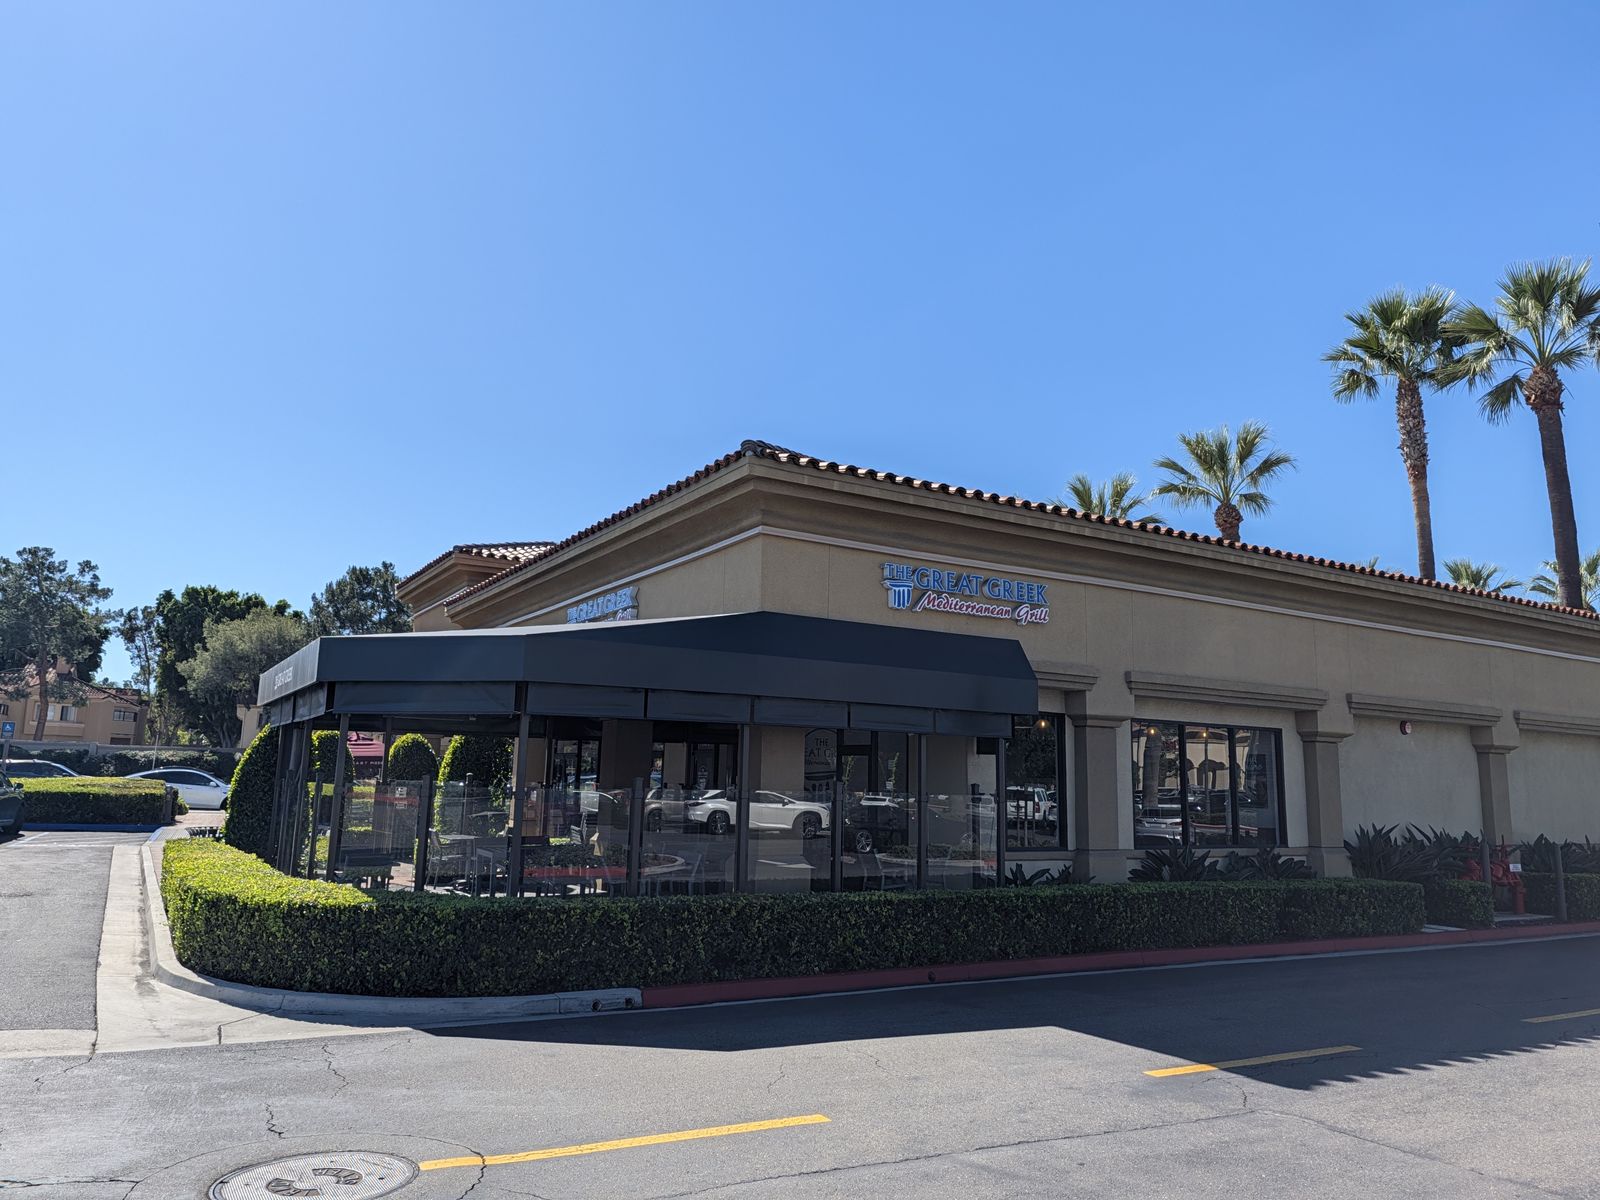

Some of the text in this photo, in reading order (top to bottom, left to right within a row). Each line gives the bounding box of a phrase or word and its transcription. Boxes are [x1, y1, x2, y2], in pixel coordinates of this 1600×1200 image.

[882, 562, 1048, 605] THE GREAT GREEK
[916, 591, 1049, 625] Mediterranean Grill
